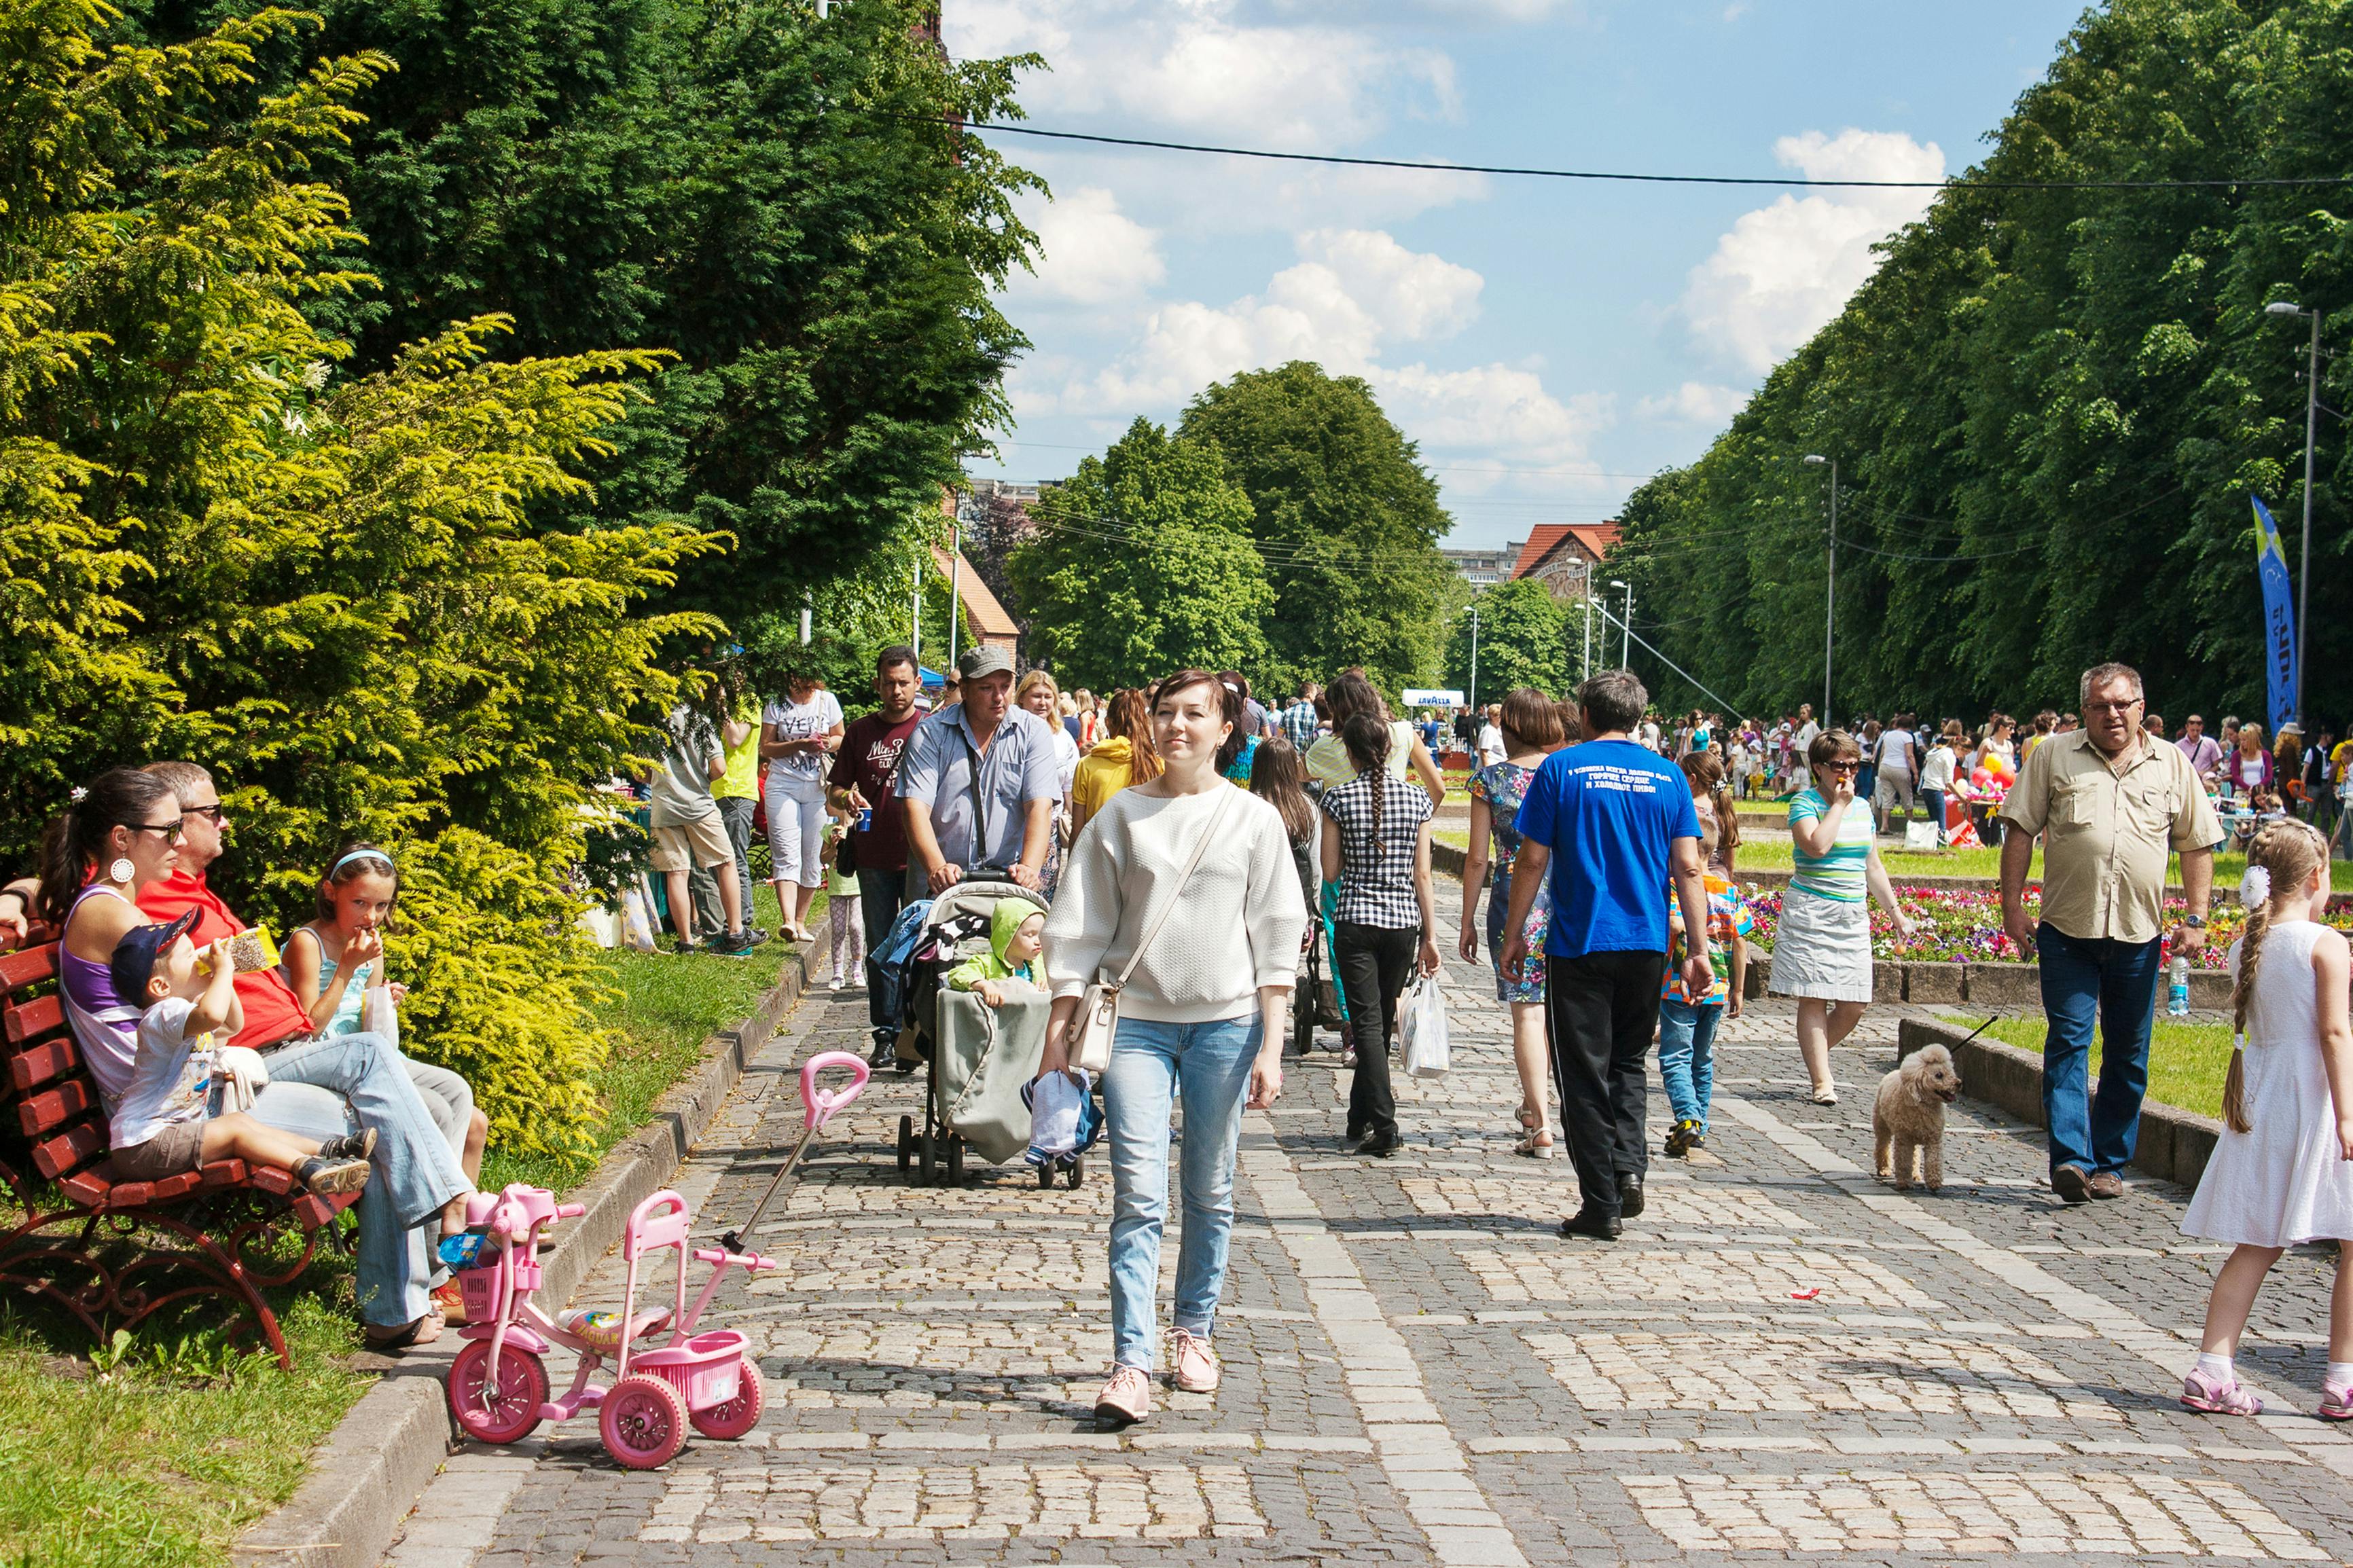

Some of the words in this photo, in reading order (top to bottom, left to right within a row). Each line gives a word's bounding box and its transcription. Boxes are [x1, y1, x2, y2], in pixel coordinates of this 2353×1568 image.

[1418, 696, 1451, 704] LAVAZZA
[1588, 773, 1620, 782] ГОРЯЧЕЕ
[1621, 775, 1650, 784] СЕРДЦЕ
[1585, 781, 1592, 789] И
[1594, 781, 1631, 791] ХОЛОДНОЕ
[1632, 784, 1656, 793] ПИВО!
[576, 1324, 619, 1345] JAGUAR
